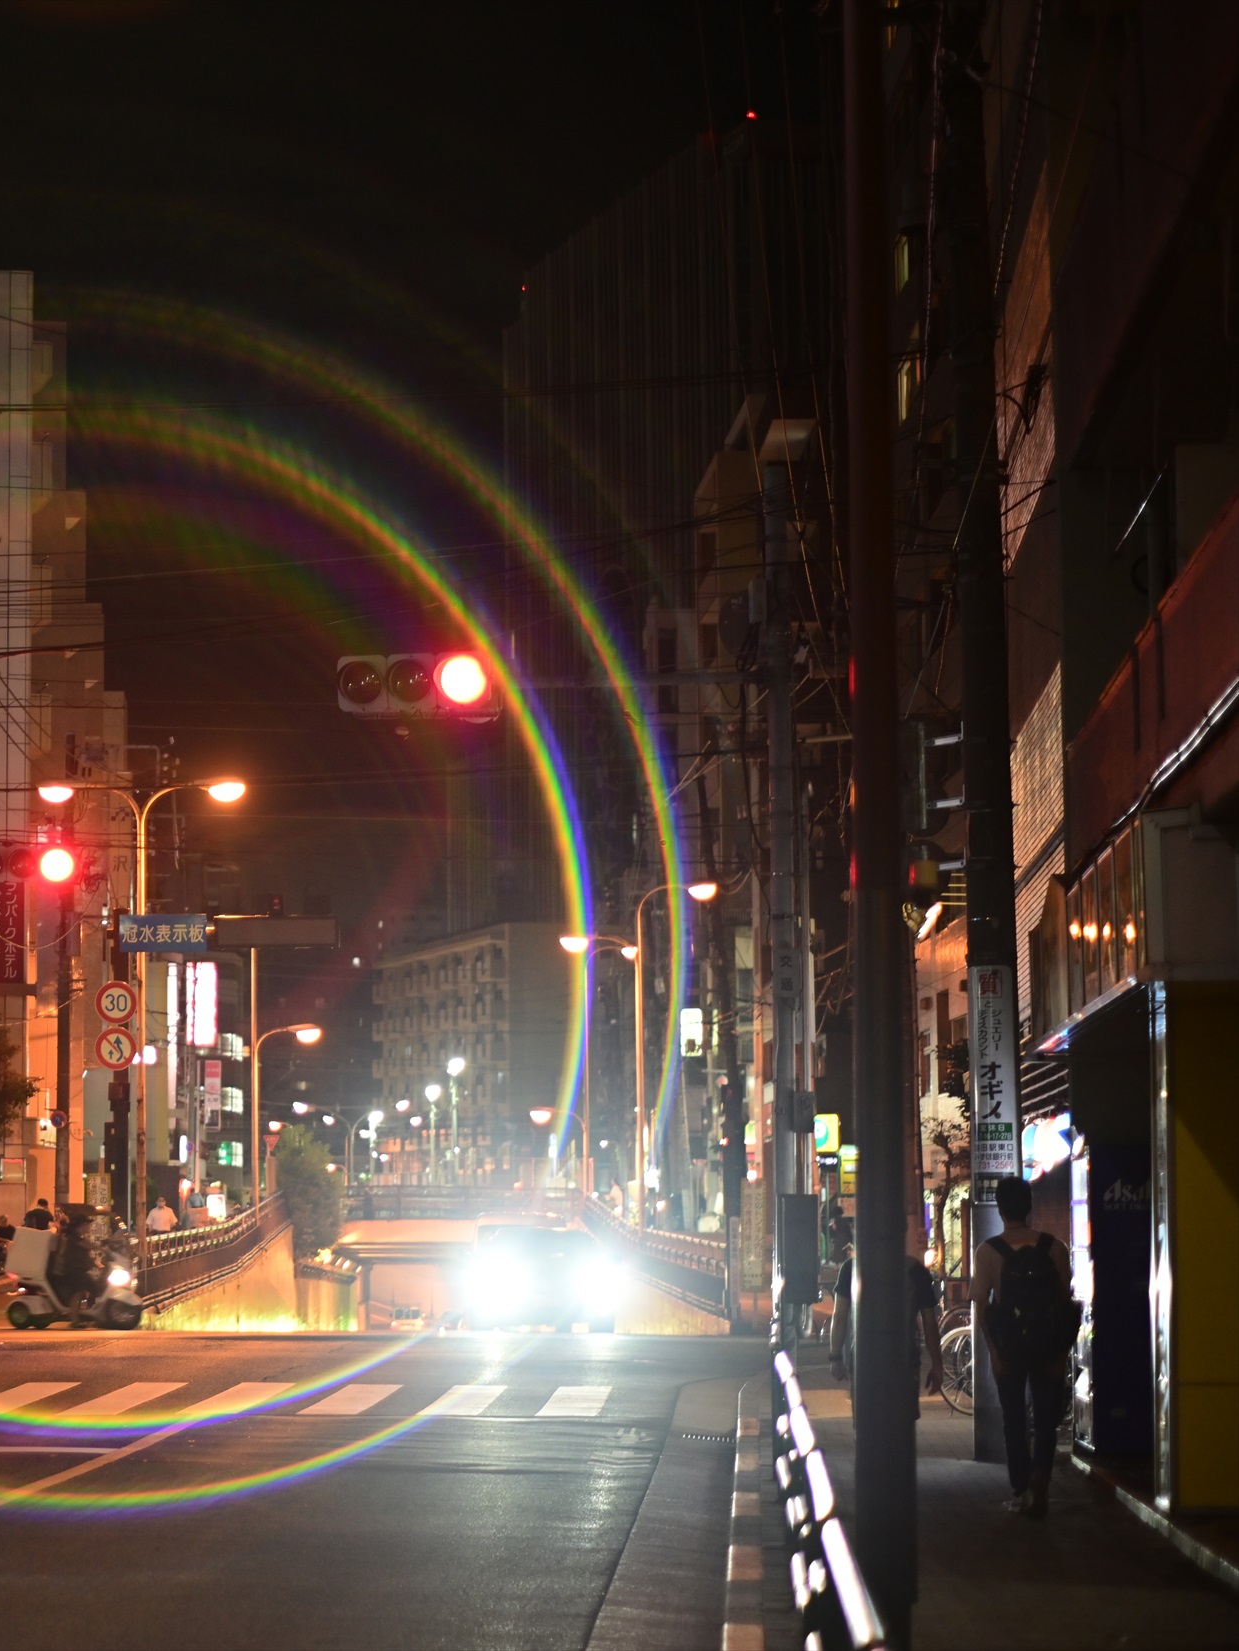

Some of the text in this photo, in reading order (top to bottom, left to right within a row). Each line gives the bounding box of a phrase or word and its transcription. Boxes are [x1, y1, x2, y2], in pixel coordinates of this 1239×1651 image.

[122, 924, 204, 943] 冠水表示板
[779, 954, 794, 992] 交通
[979, 973, 999, 995] 質
[105, 993, 128, 1012] 30
